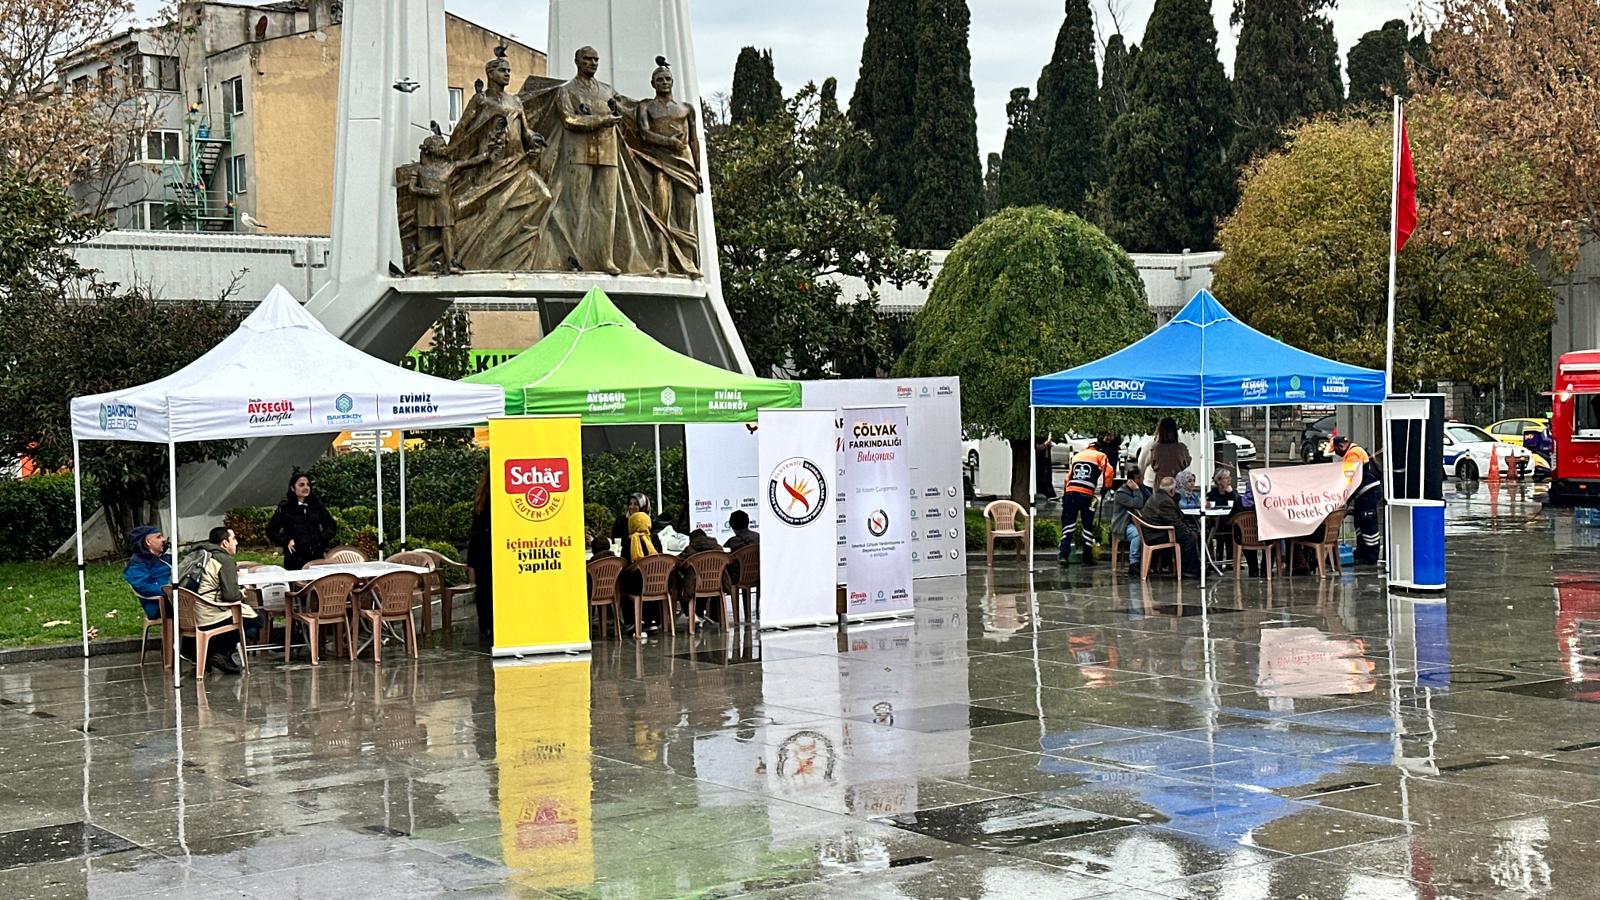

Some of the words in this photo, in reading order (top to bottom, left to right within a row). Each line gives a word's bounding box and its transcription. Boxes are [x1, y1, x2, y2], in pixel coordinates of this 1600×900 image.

[400, 392, 431, 403] EVİMİZ
[248, 399, 296, 415] AYŞEGÜL
[392, 403, 438, 414] BAKIRKÖY
[854, 422, 897, 438] ÇÖLYAK
[849, 437, 902, 448] FARKINDALIĞI
[510, 466, 564, 488] Schär
[514, 496, 560, 518] GLUTEN-FREE
[1263, 494, 1299, 512] Çölyak
[1301, 490, 1320, 506] İçin
[1322, 490, 1340, 502] Ses
[1287, 505, 1323, 520] Destek
[506, 536, 572, 552] içimizdeki
[518, 548, 561, 562] iyilikle
[518, 560, 562, 574] yapıldı
